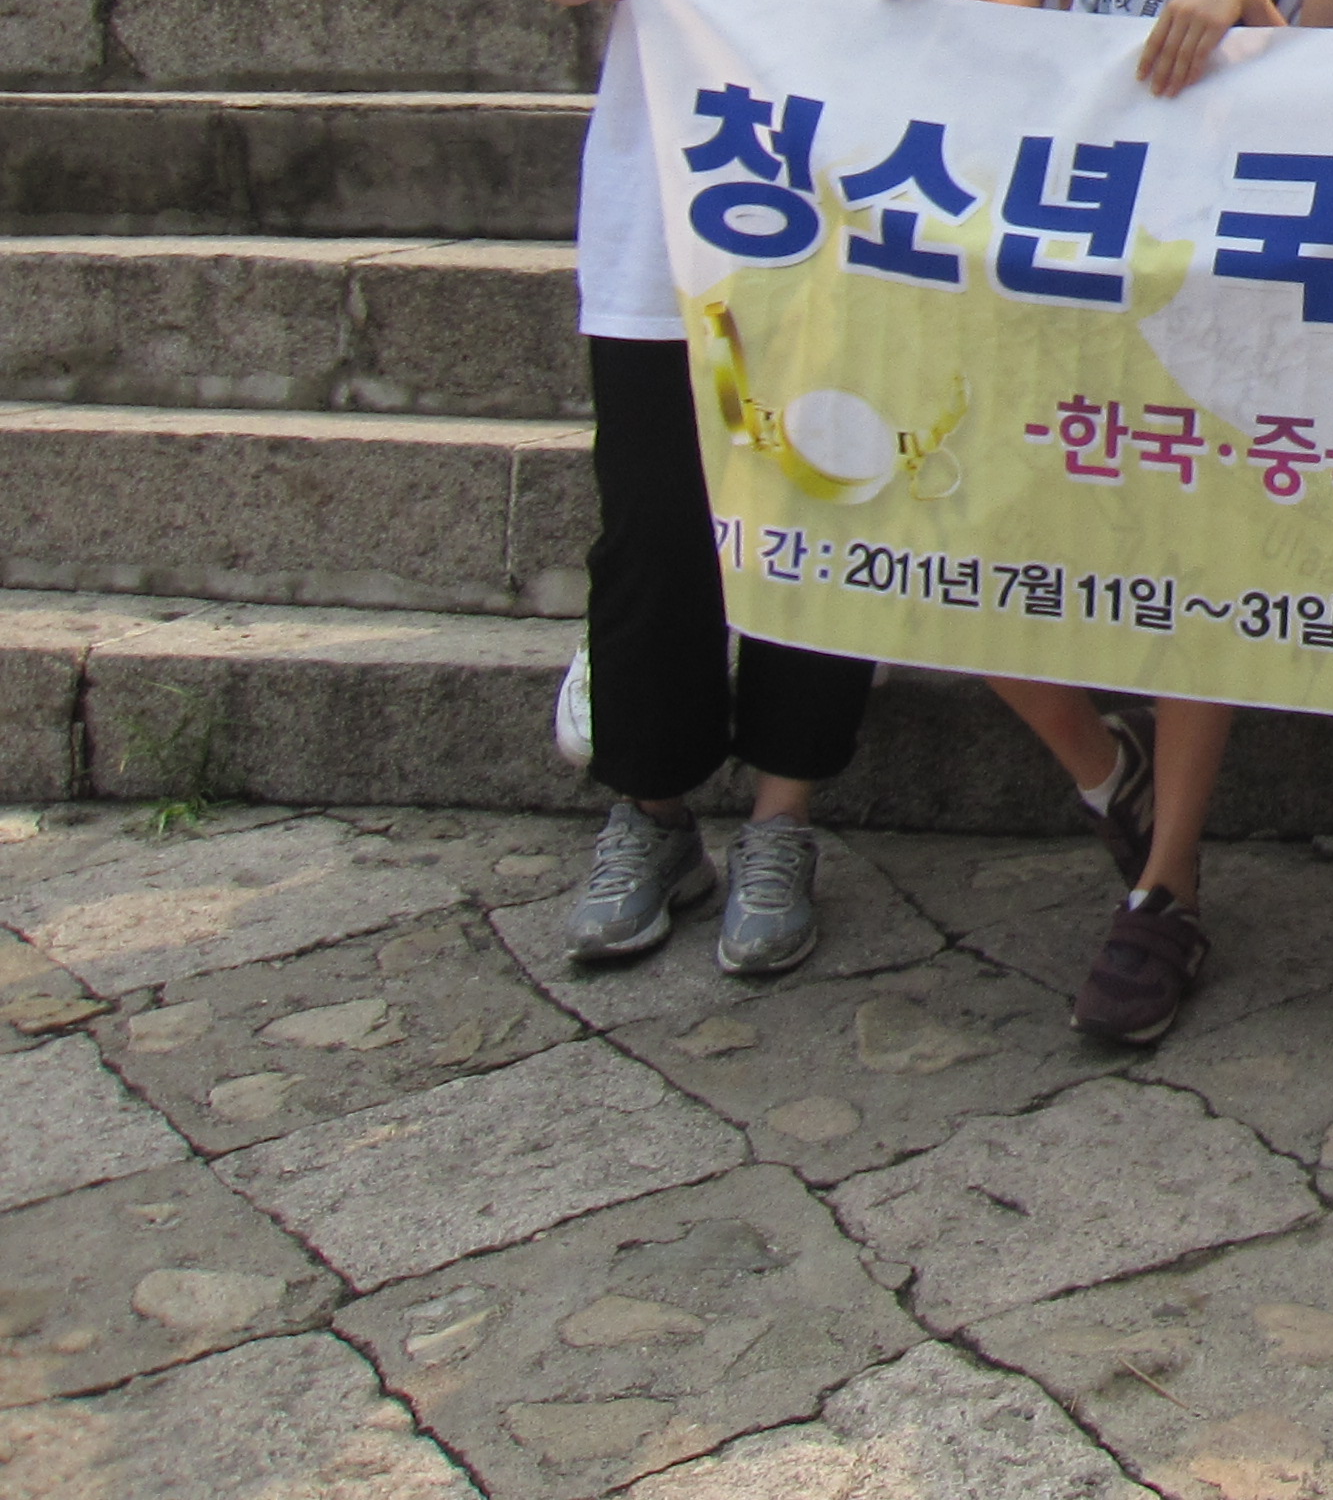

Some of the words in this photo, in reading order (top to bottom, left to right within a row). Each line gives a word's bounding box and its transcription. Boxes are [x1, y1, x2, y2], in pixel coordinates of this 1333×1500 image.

[683, 83, 1149, 304] 청소년
[845, 541, 982, 609] 2011년
[990, 564, 1064, 618] 7월
